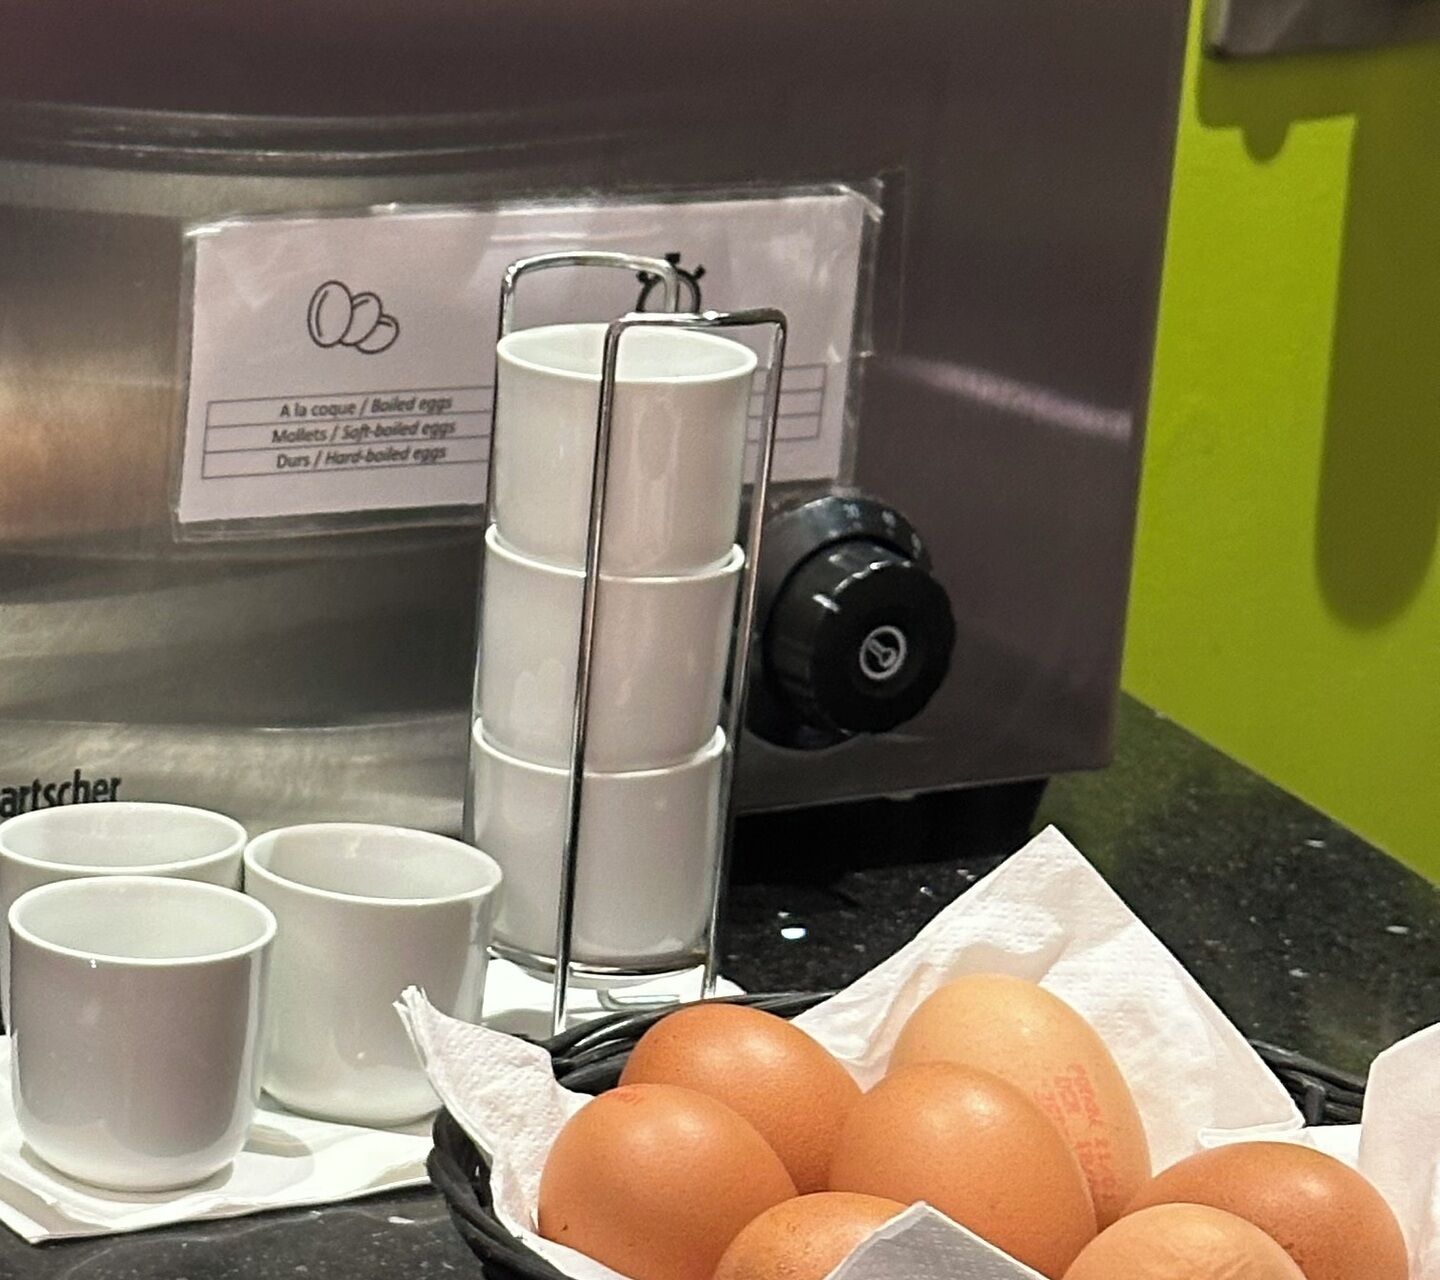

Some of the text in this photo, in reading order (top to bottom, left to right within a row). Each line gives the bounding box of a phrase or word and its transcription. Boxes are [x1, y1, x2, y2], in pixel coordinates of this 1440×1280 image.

[280, 404, 290, 418] A
[294, 402, 307, 416] la
[311, 403, 356, 419] coque
[371, 396, 416, 414] Boiled
[418, 397, 453, 415] eggs
[272, 428, 327, 444] Mollets
[341, 421, 420, 442] Soft-boiled
[421, 422, 456, 440] eggs
[276, 453, 310, 469] Durs
[325, 446, 410, 465] Hard-boiled
[412, 447, 447, 465] eggs
